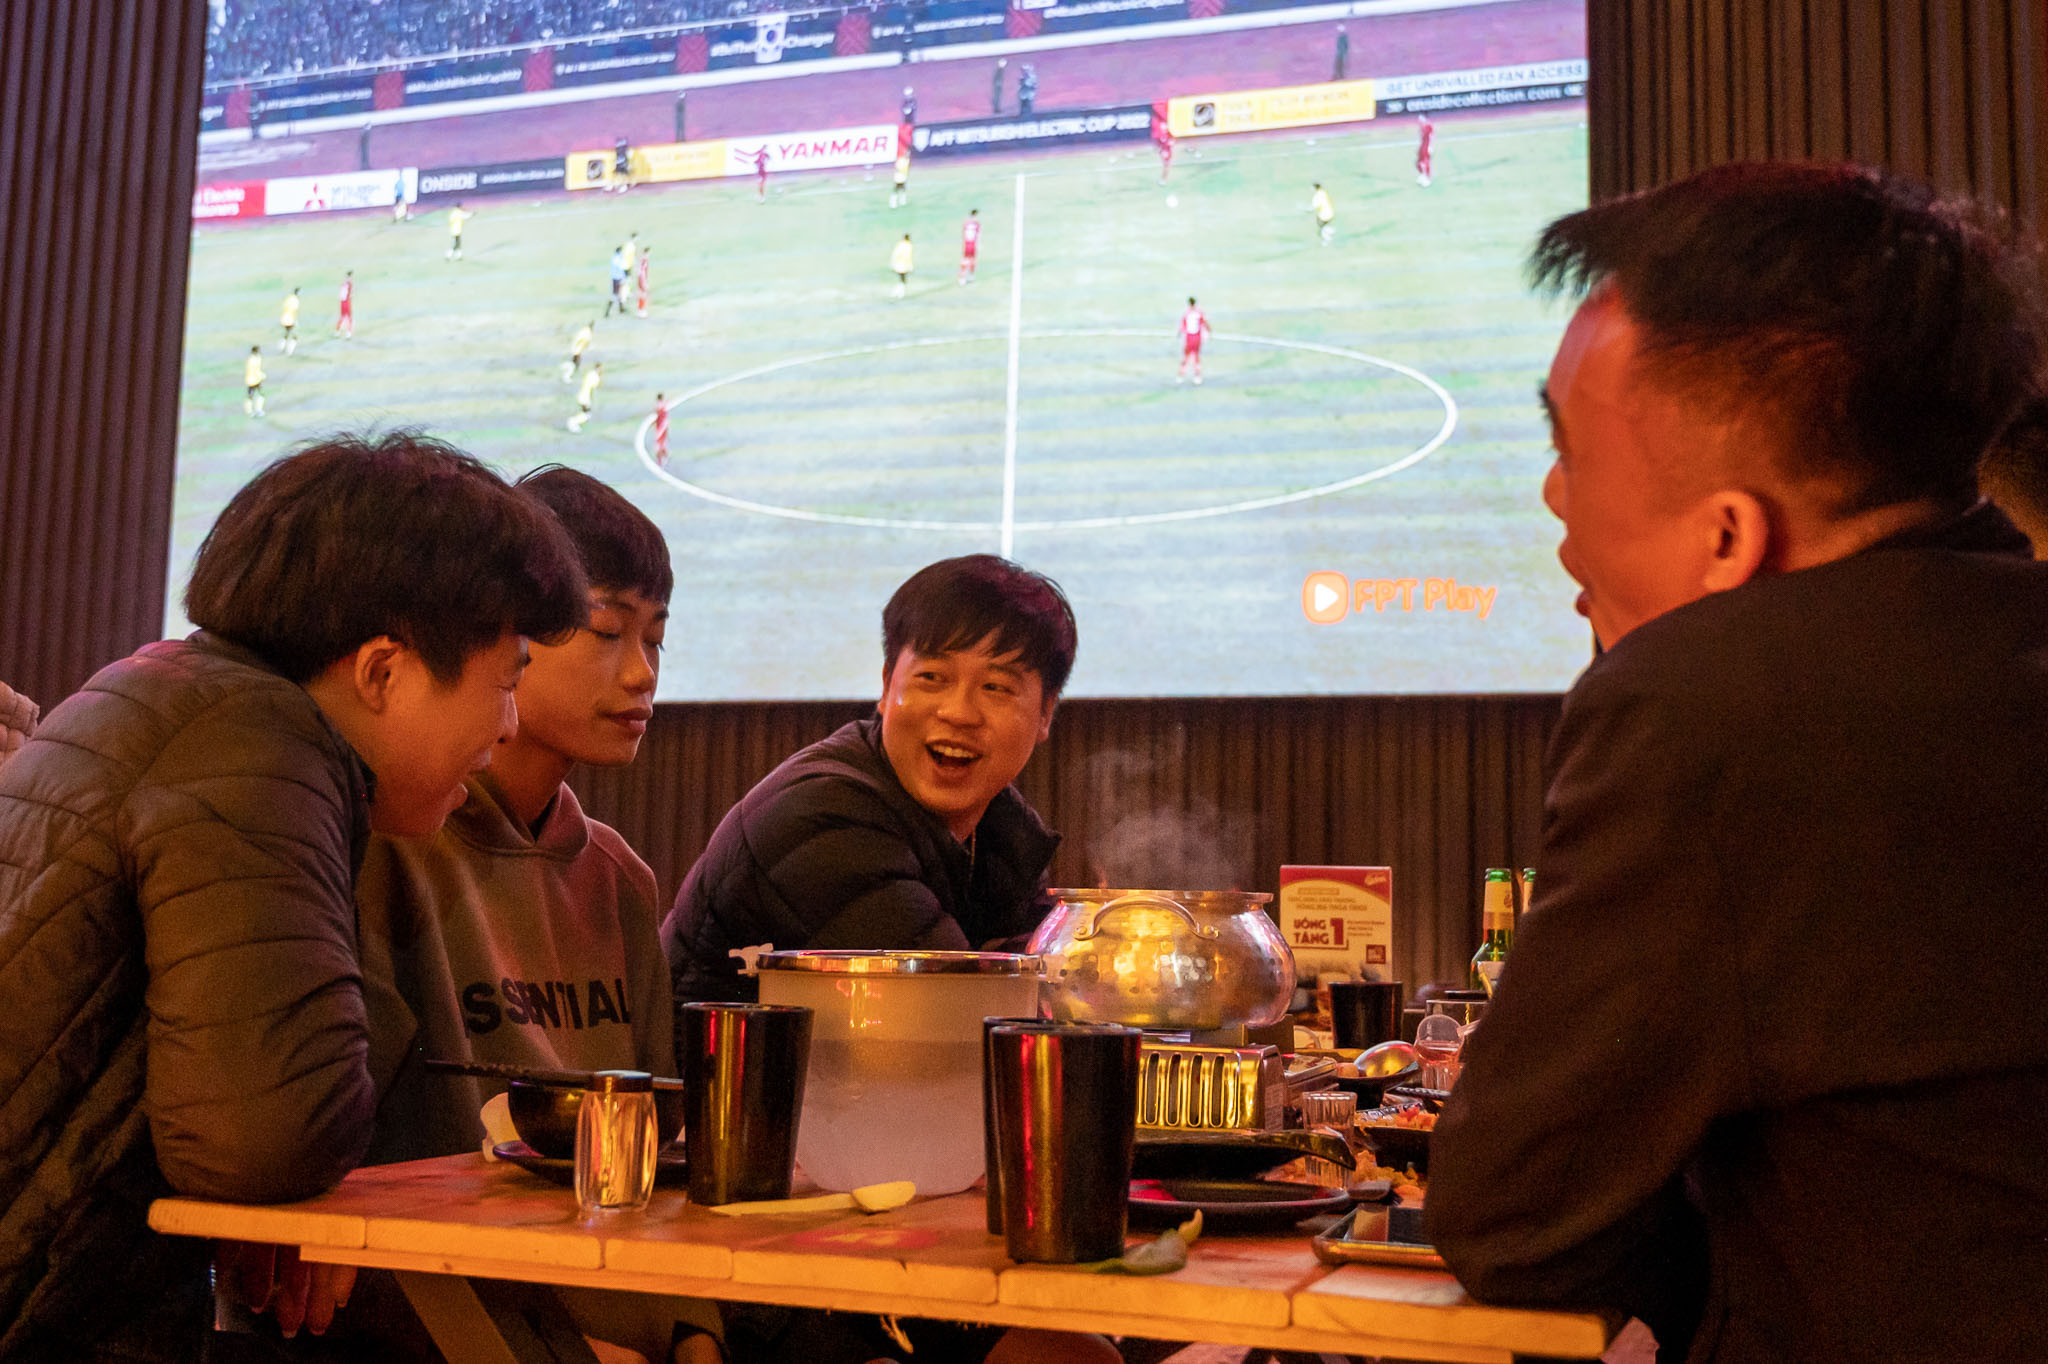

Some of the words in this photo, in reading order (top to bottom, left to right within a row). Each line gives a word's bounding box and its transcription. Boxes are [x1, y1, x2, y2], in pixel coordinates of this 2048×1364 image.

[1498, 69, 1524, 82] FAN
[1528, 63, 1583, 80] ACCESS
[779, 135, 889, 160] YANMAR
[420, 172, 478, 194] ONSIDE
[1354, 577, 1419, 613] FPT
[1424, 576, 1497, 620] Play
